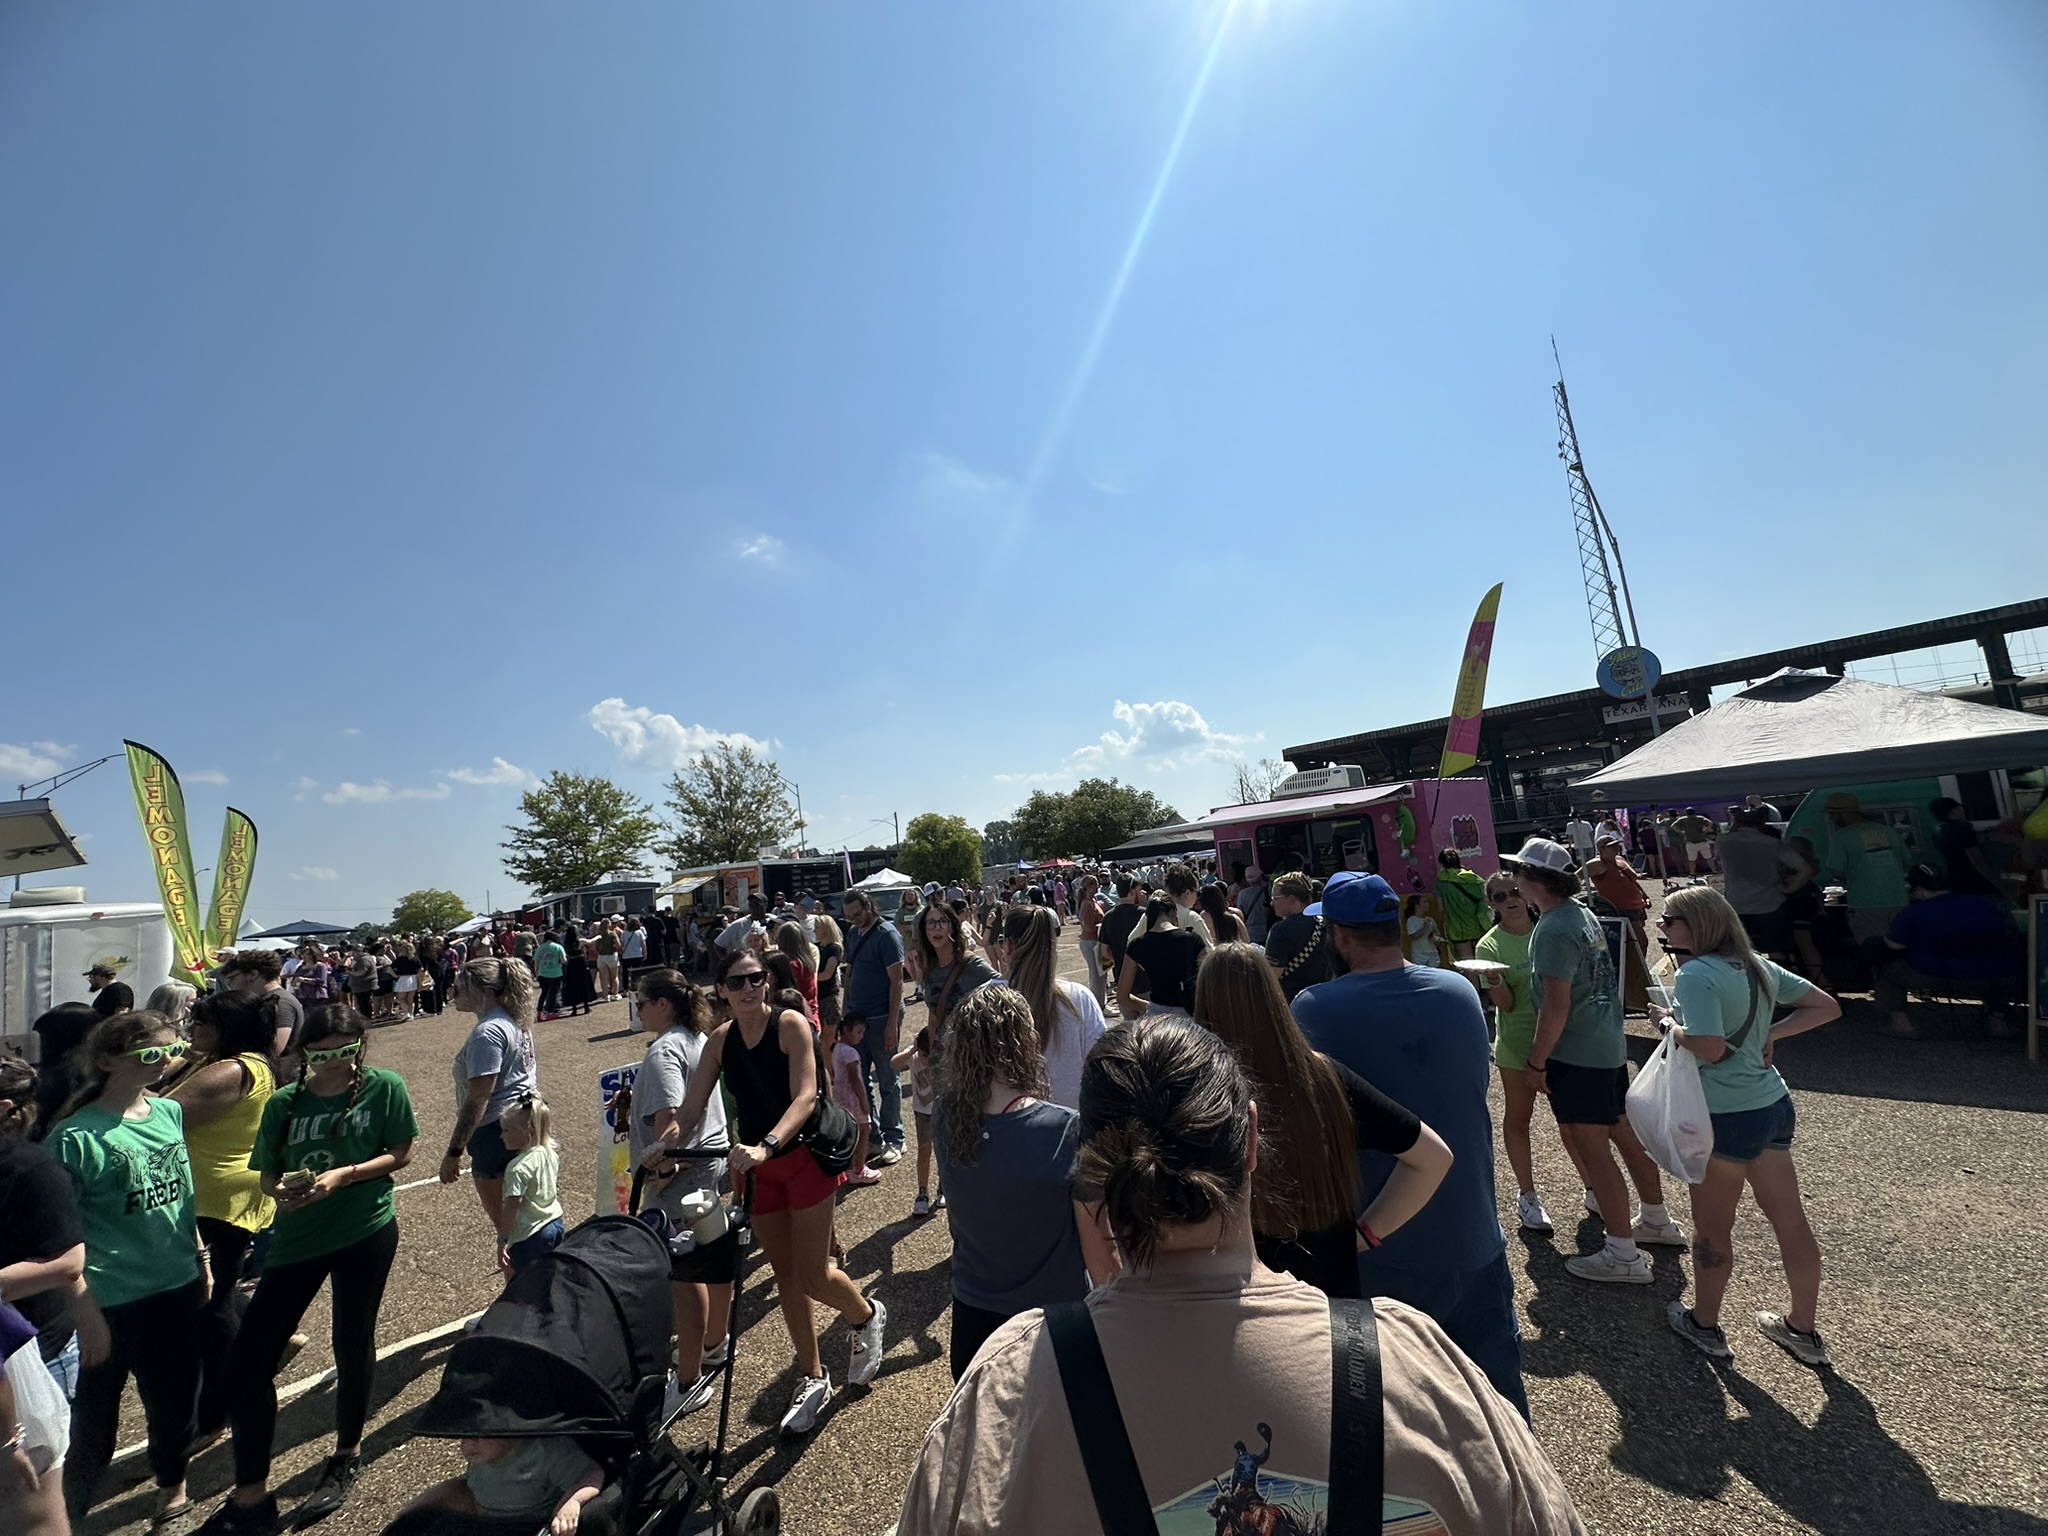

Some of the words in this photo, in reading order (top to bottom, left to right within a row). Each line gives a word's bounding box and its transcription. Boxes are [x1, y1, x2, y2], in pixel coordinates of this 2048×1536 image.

[1604, 697, 1687, 718] TEXARANA
[288, 1110, 371, 1146] UCY
[124, 1178, 180, 1215] FREE
